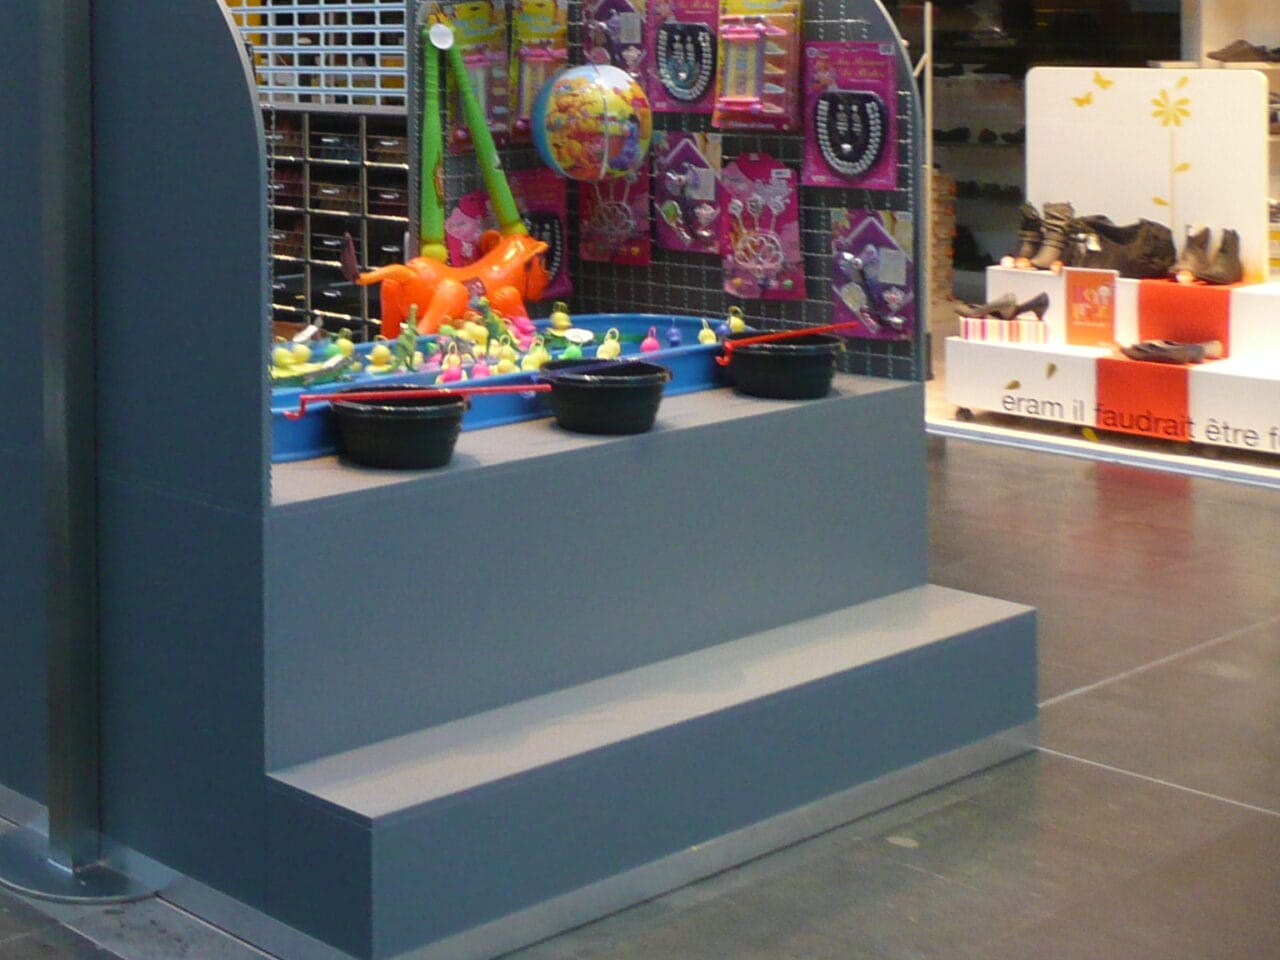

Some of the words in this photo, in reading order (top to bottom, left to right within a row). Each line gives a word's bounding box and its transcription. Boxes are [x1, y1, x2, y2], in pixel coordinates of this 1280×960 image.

[1072, 399, 1085, 422] il
[1093, 402, 1195, 438] faudrait
[1205, 418, 1260, 447] être
